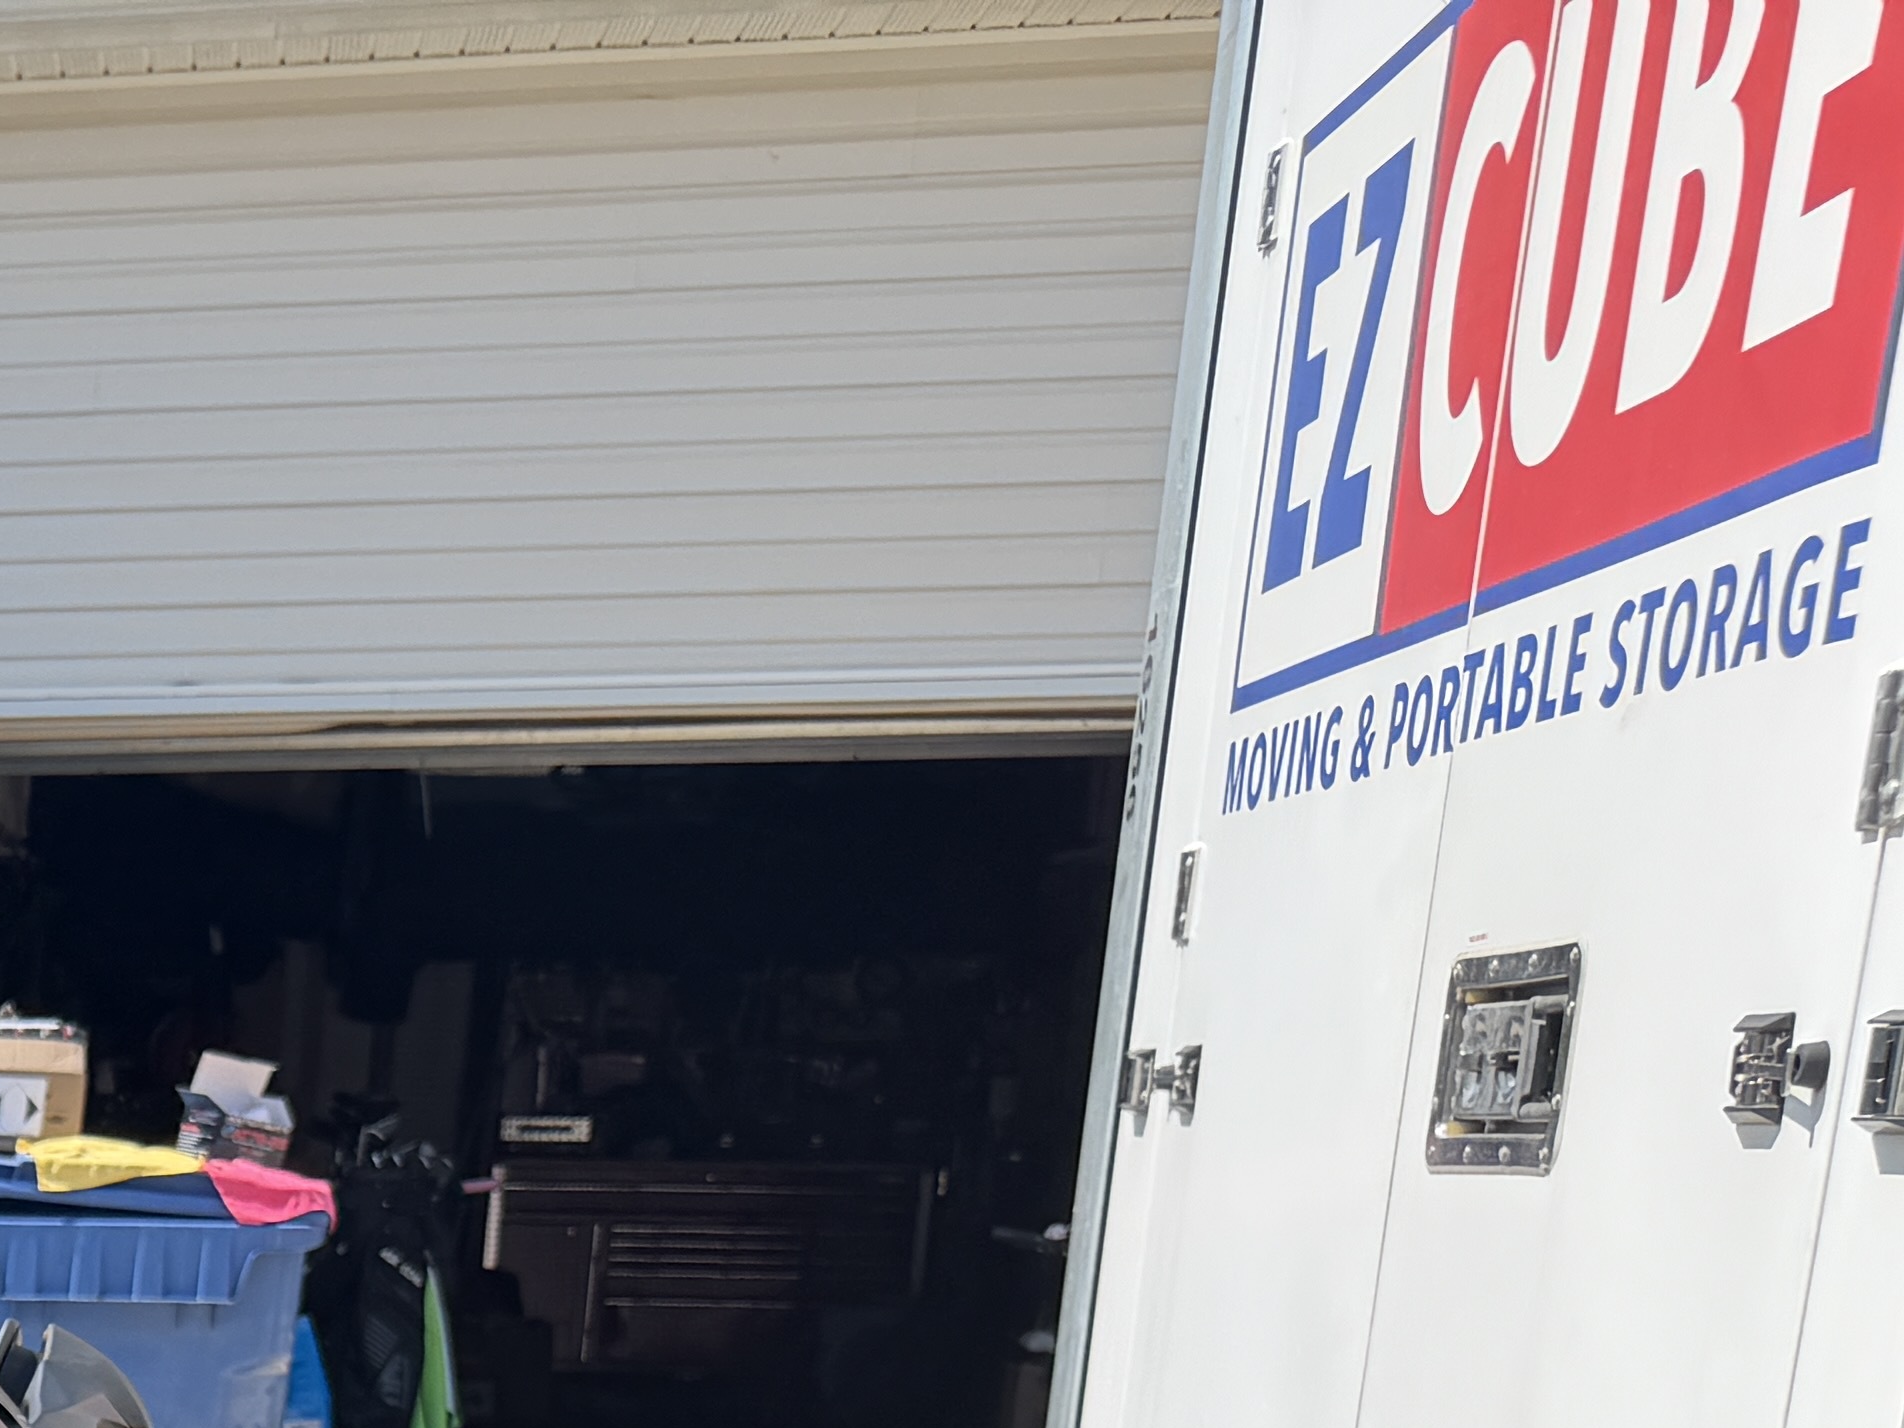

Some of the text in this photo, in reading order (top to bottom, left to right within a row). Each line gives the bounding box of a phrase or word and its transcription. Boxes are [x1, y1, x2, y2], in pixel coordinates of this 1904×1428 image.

[1261, 0, 1884, 594] EZ CUBE
[1222, 697, 1340, 816] MOVING
[1348, 727, 1376, 783] &
[1383, 612, 1594, 769] PORTABLE
[1600, 516, 1872, 711] STORAGE
